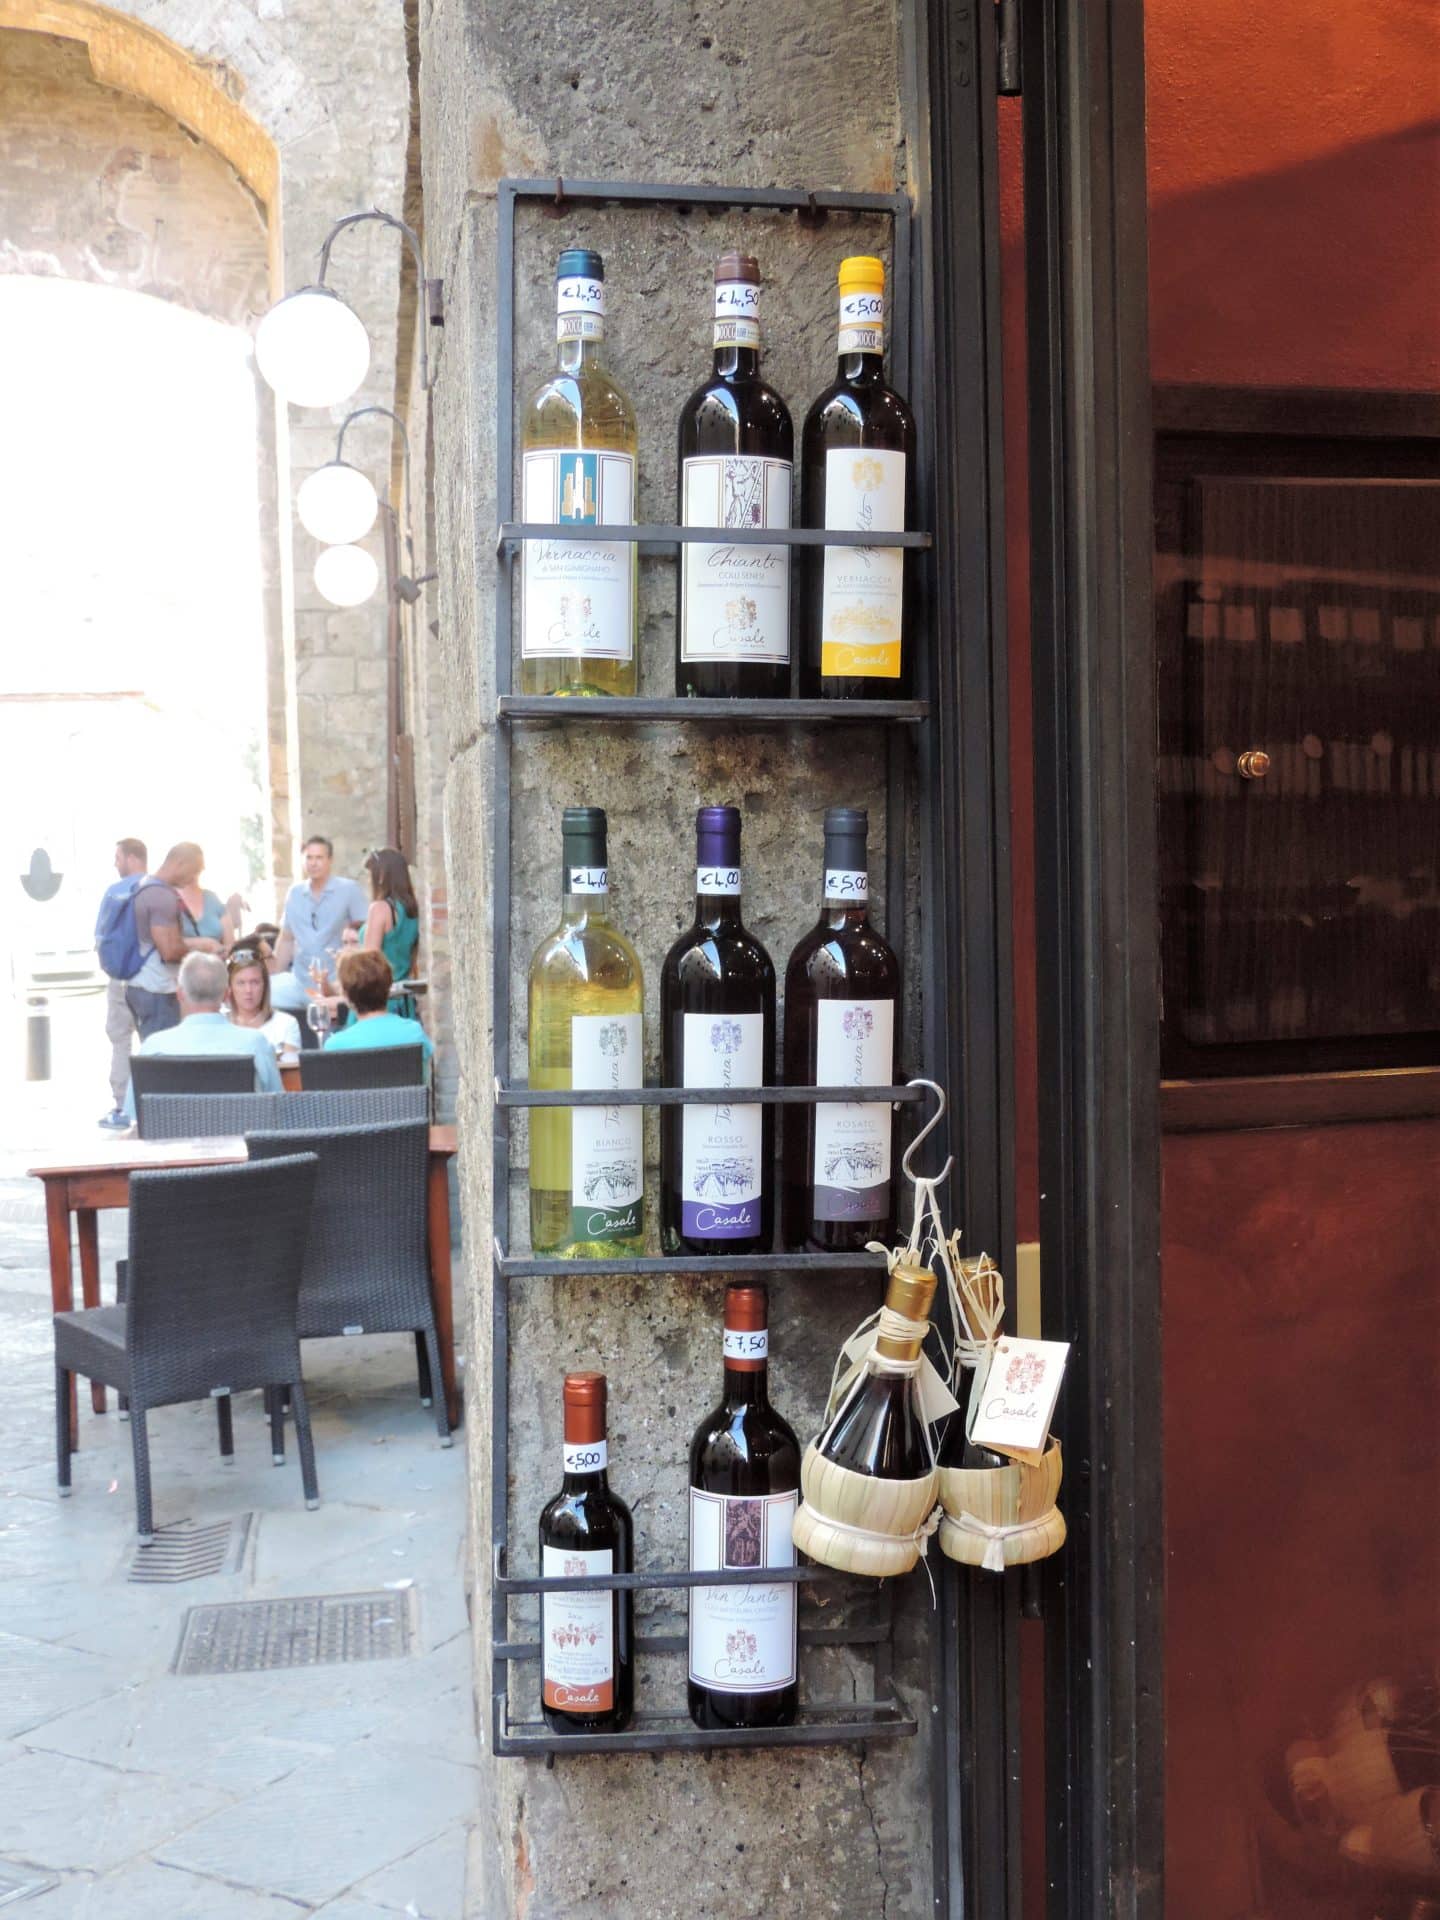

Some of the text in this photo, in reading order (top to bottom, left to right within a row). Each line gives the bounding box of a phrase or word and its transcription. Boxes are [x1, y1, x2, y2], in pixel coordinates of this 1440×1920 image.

[845, 297, 882, 316] €5,00
[533, 542, 617, 564] Vernaccia
[707, 547, 785, 569] Chianti
[573, 871, 608, 888] €4,0
[701, 872, 738, 888] €4,00
[828, 876, 867, 893] €5,00
[595, 1137, 632, 1148] BIANCO
[707, 1135, 743, 1144] ROSSO
[587, 1209, 636, 1235] Casale
[696, 1208, 751, 1231] Casale
[725, 1336, 766, 1353] €7,50
[985, 1397, 1039, 1420] Casale
[566, 1452, 601, 1471] €5,00
[714, 1657, 767, 1680] Casale
[553, 1686, 600, 1706] Casale
